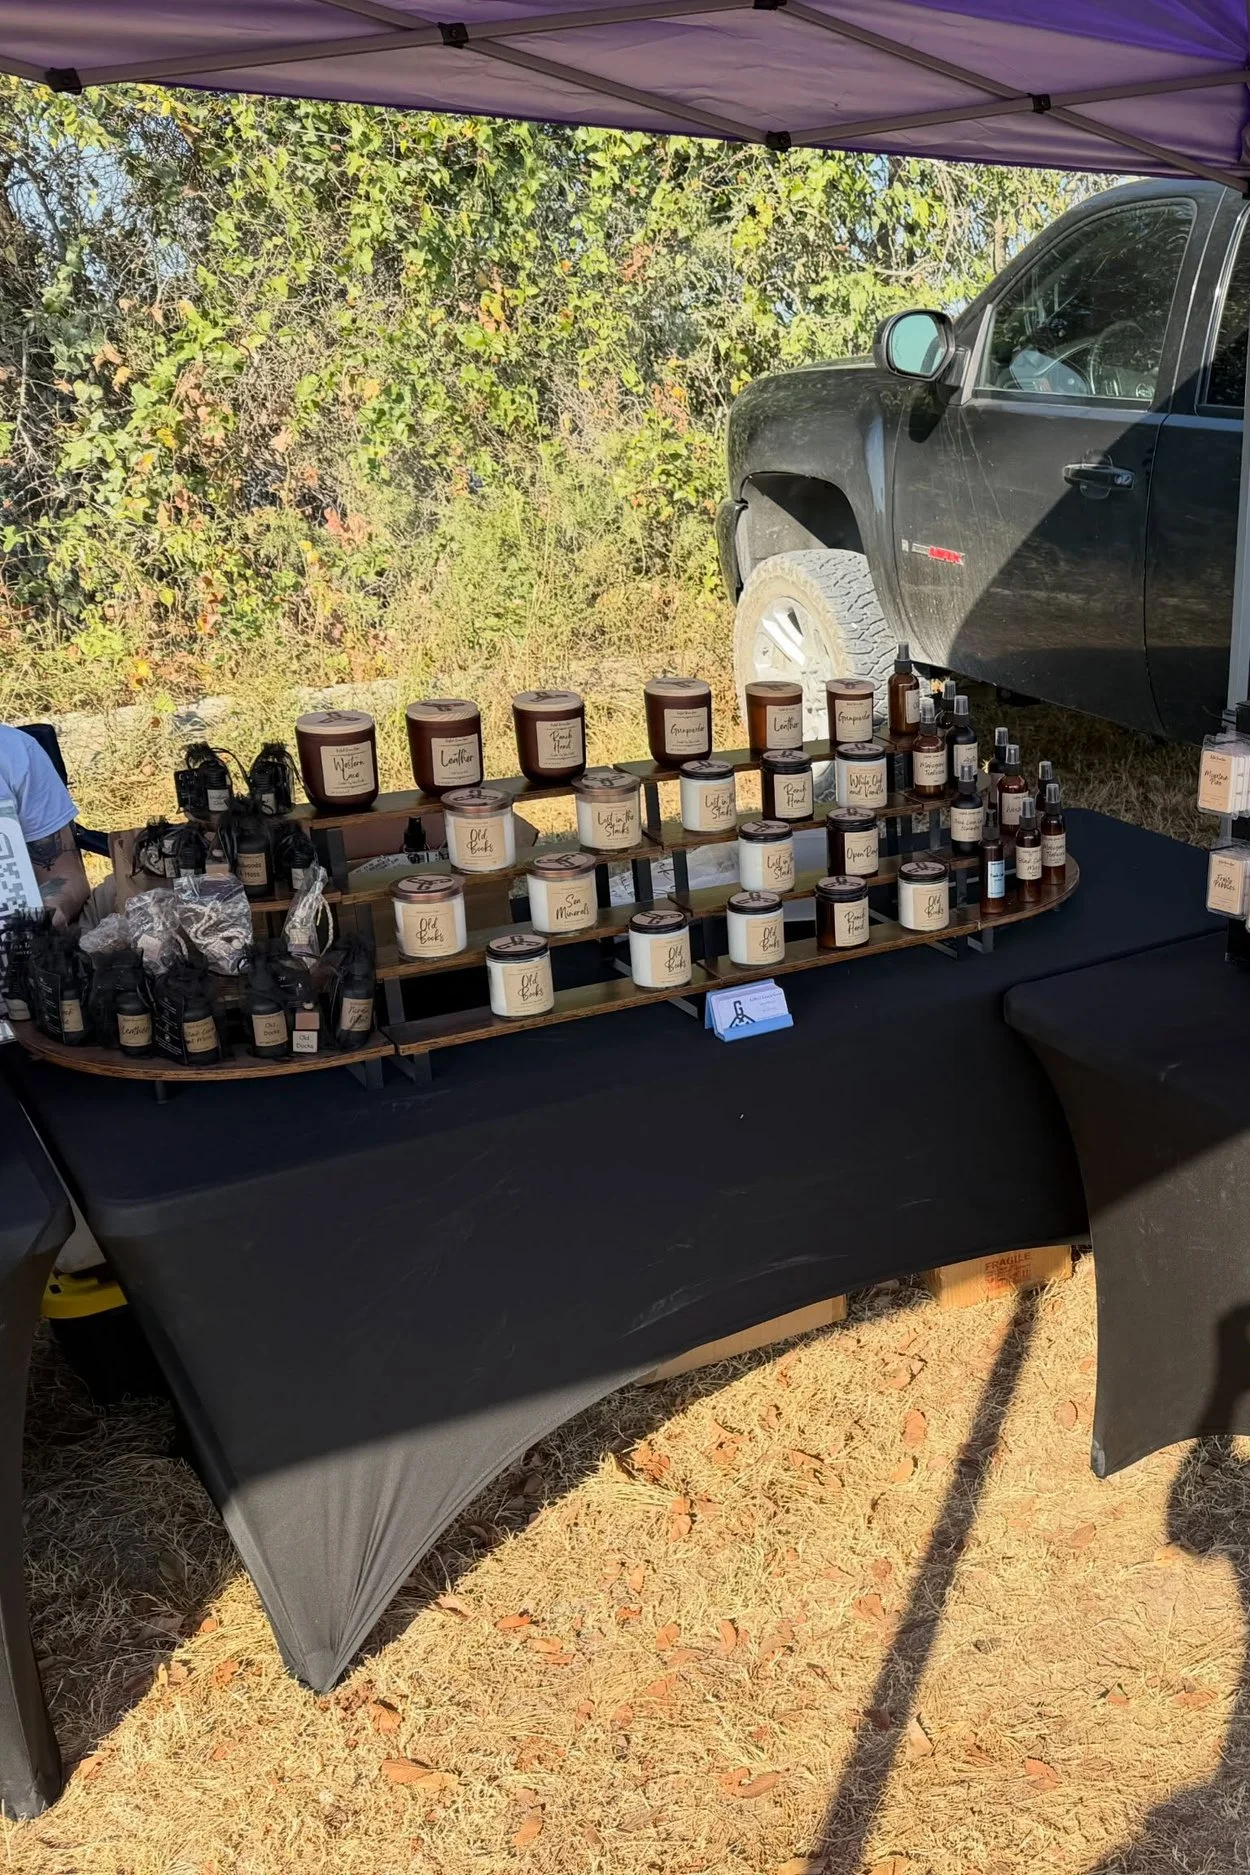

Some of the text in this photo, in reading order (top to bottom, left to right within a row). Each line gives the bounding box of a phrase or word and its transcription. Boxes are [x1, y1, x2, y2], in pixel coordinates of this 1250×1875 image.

[774, 716, 799, 733] Leather
[333, 756, 365, 772] Western
[441, 749, 474, 767] Leather
[598, 809, 614, 826] Lost
[469, 828, 488, 842] Old
[605, 822, 630, 838] Stacks
[466, 840, 494, 855] Books
[846, 847, 863, 863] Open
[565, 894, 581, 908] Sea
[556, 904, 590, 920] Minerals
[419, 918, 437, 932] Old
[763, 926, 778, 939] Old
[416, 929, 445, 944] Books
[759, 937, 780, 952] Books
[668, 945, 682, 960] Old
[664, 957, 687, 973] Books
[521, 972, 538, 988] Old
[517, 985, 544, 1001] Books
[985, 1252, 1031, 1271] FRAGILE
